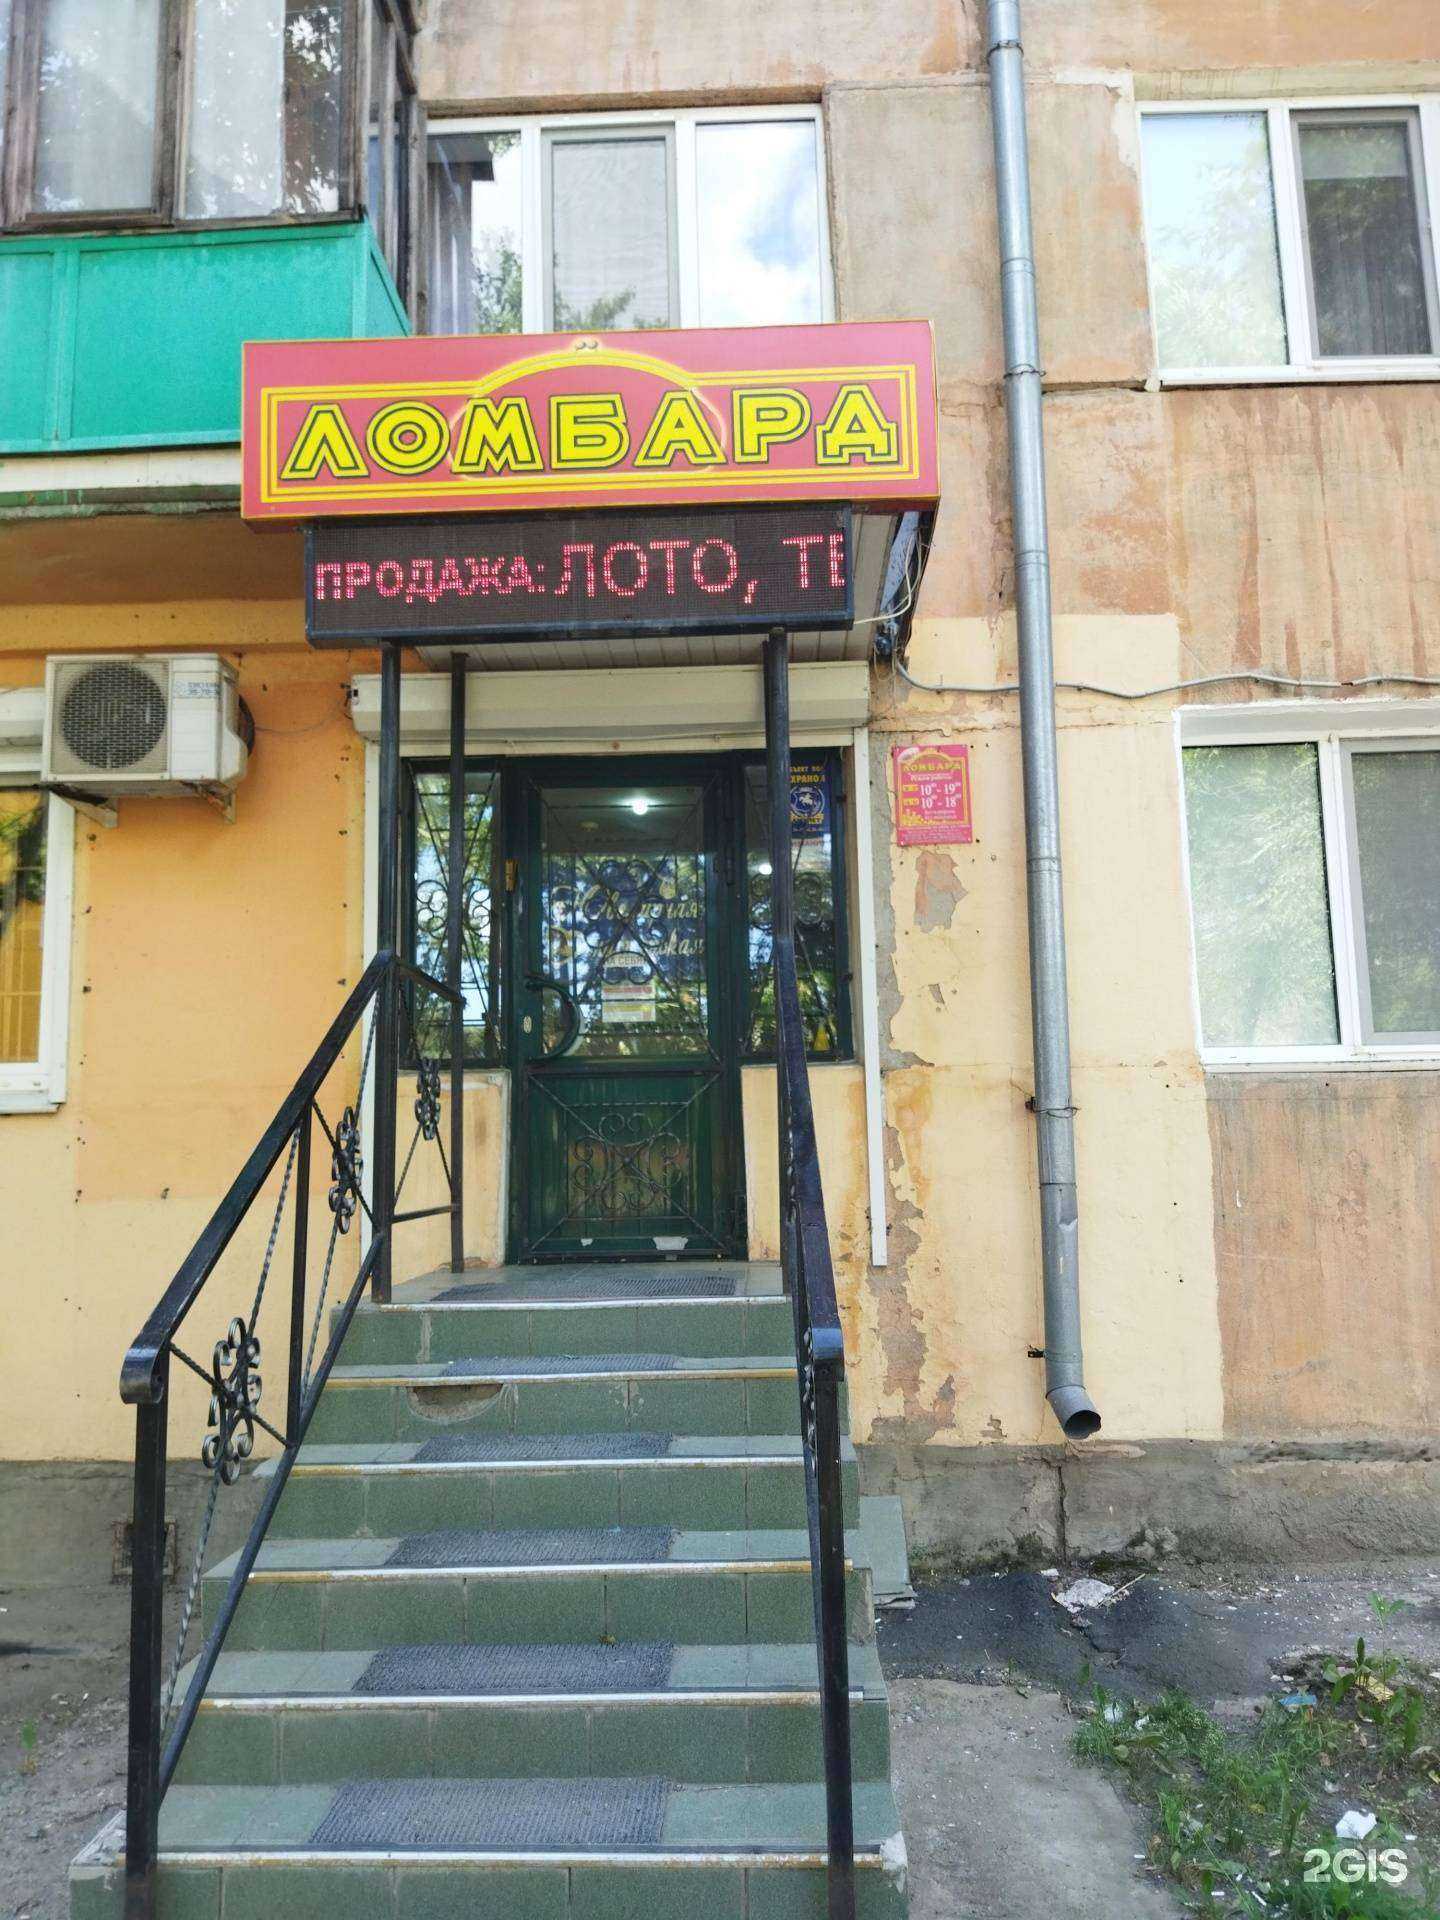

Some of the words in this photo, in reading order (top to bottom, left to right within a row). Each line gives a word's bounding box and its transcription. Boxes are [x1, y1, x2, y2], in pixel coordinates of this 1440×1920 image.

[280, 384, 900, 480] ЛОМБАРД
[315, 554, 546, 604] ПРОДАЖА:
[554, 536, 759, 605] ЛОТО,
